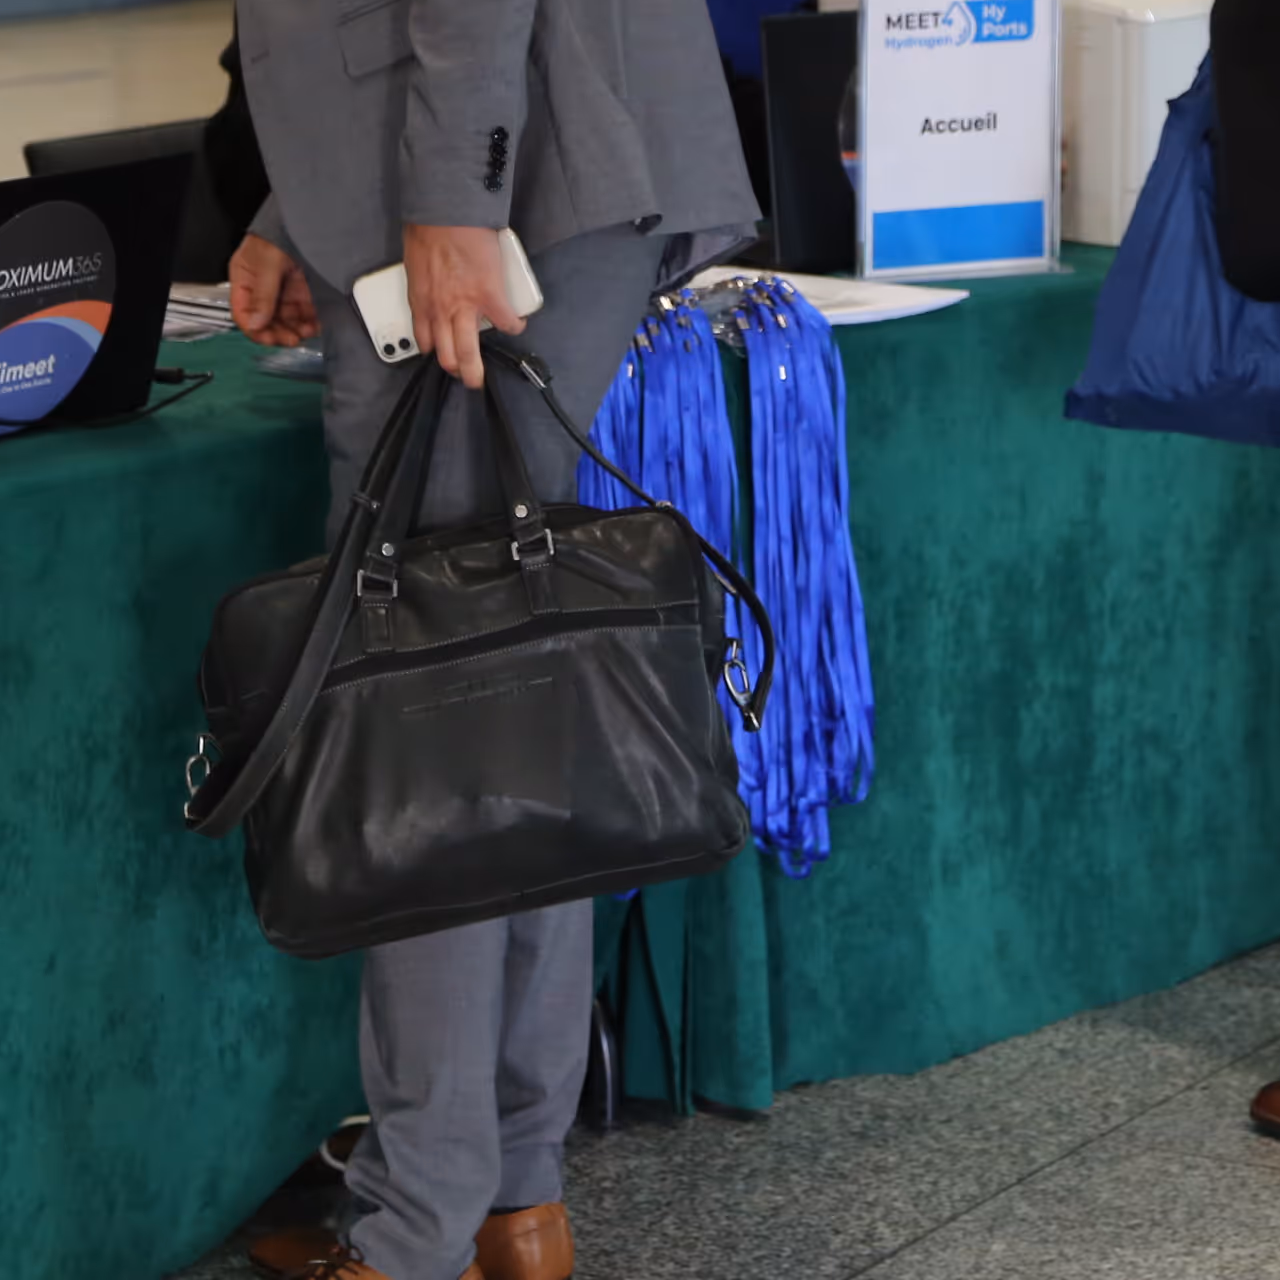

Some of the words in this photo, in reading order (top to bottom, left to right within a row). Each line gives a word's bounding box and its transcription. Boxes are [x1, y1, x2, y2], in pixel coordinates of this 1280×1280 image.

[982, 3, 1007, 22] Hy
[982, 21, 1028, 38] Ports
[884, 35, 953, 52] Hydrogen
[920, 111, 998, 136] Accueil
